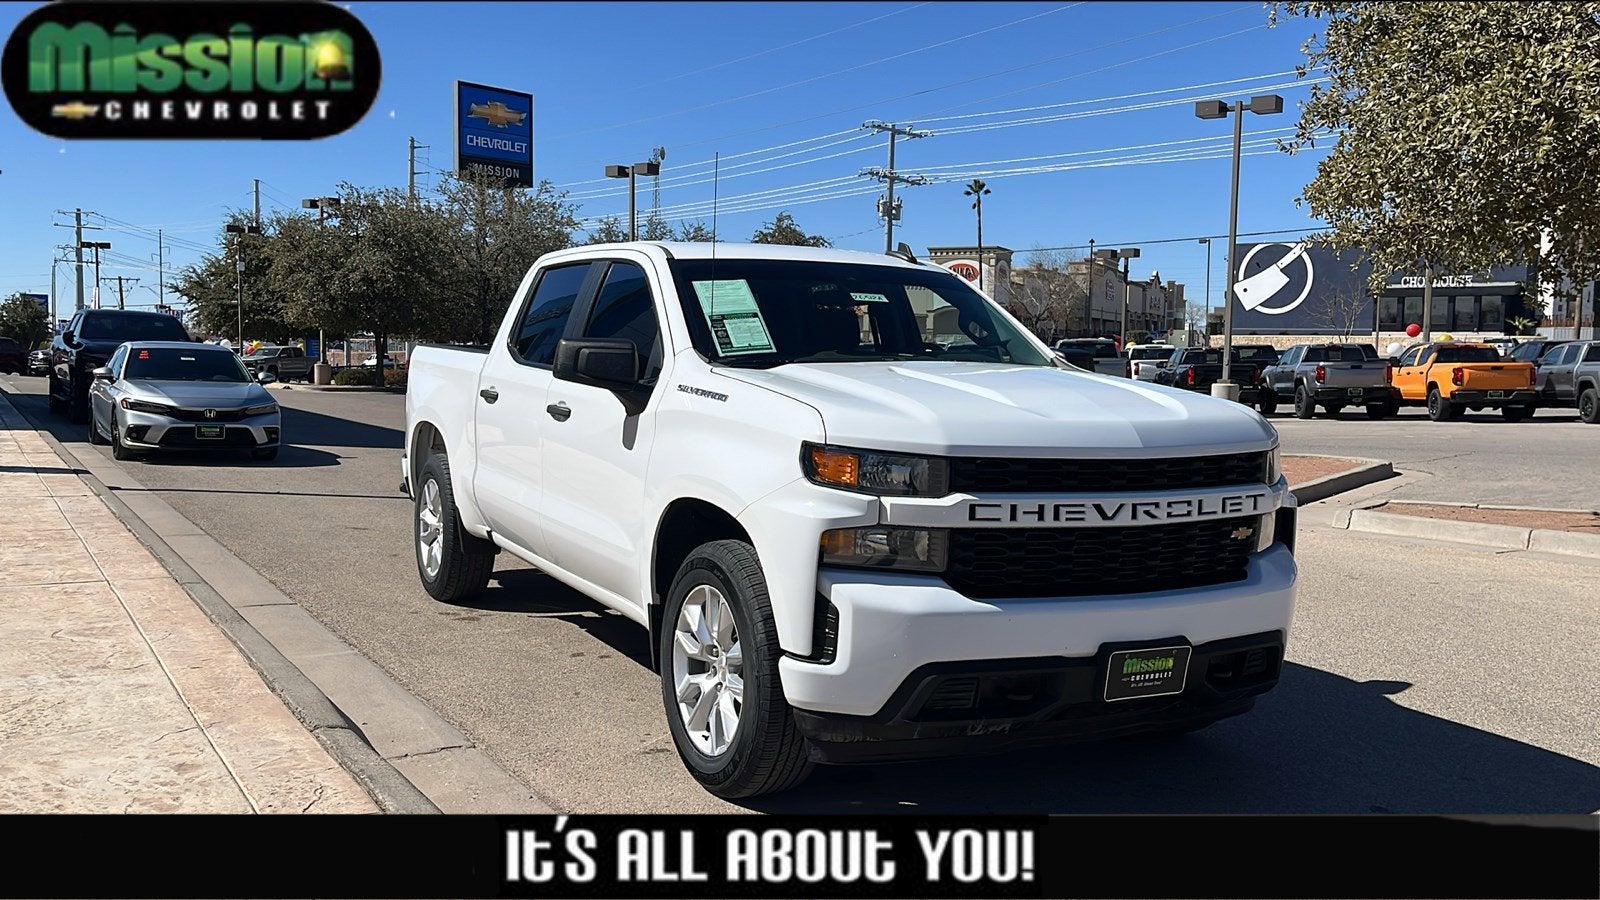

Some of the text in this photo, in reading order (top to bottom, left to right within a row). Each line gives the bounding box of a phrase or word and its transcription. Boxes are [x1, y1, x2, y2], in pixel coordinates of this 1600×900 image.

[466, 134, 528, 153] CHEVROLET
[1401, 275, 1473, 288] CHOHOUSE
[968, 493, 1266, 523] CHEVROLET
[1123, 657, 1175, 674] Mission
